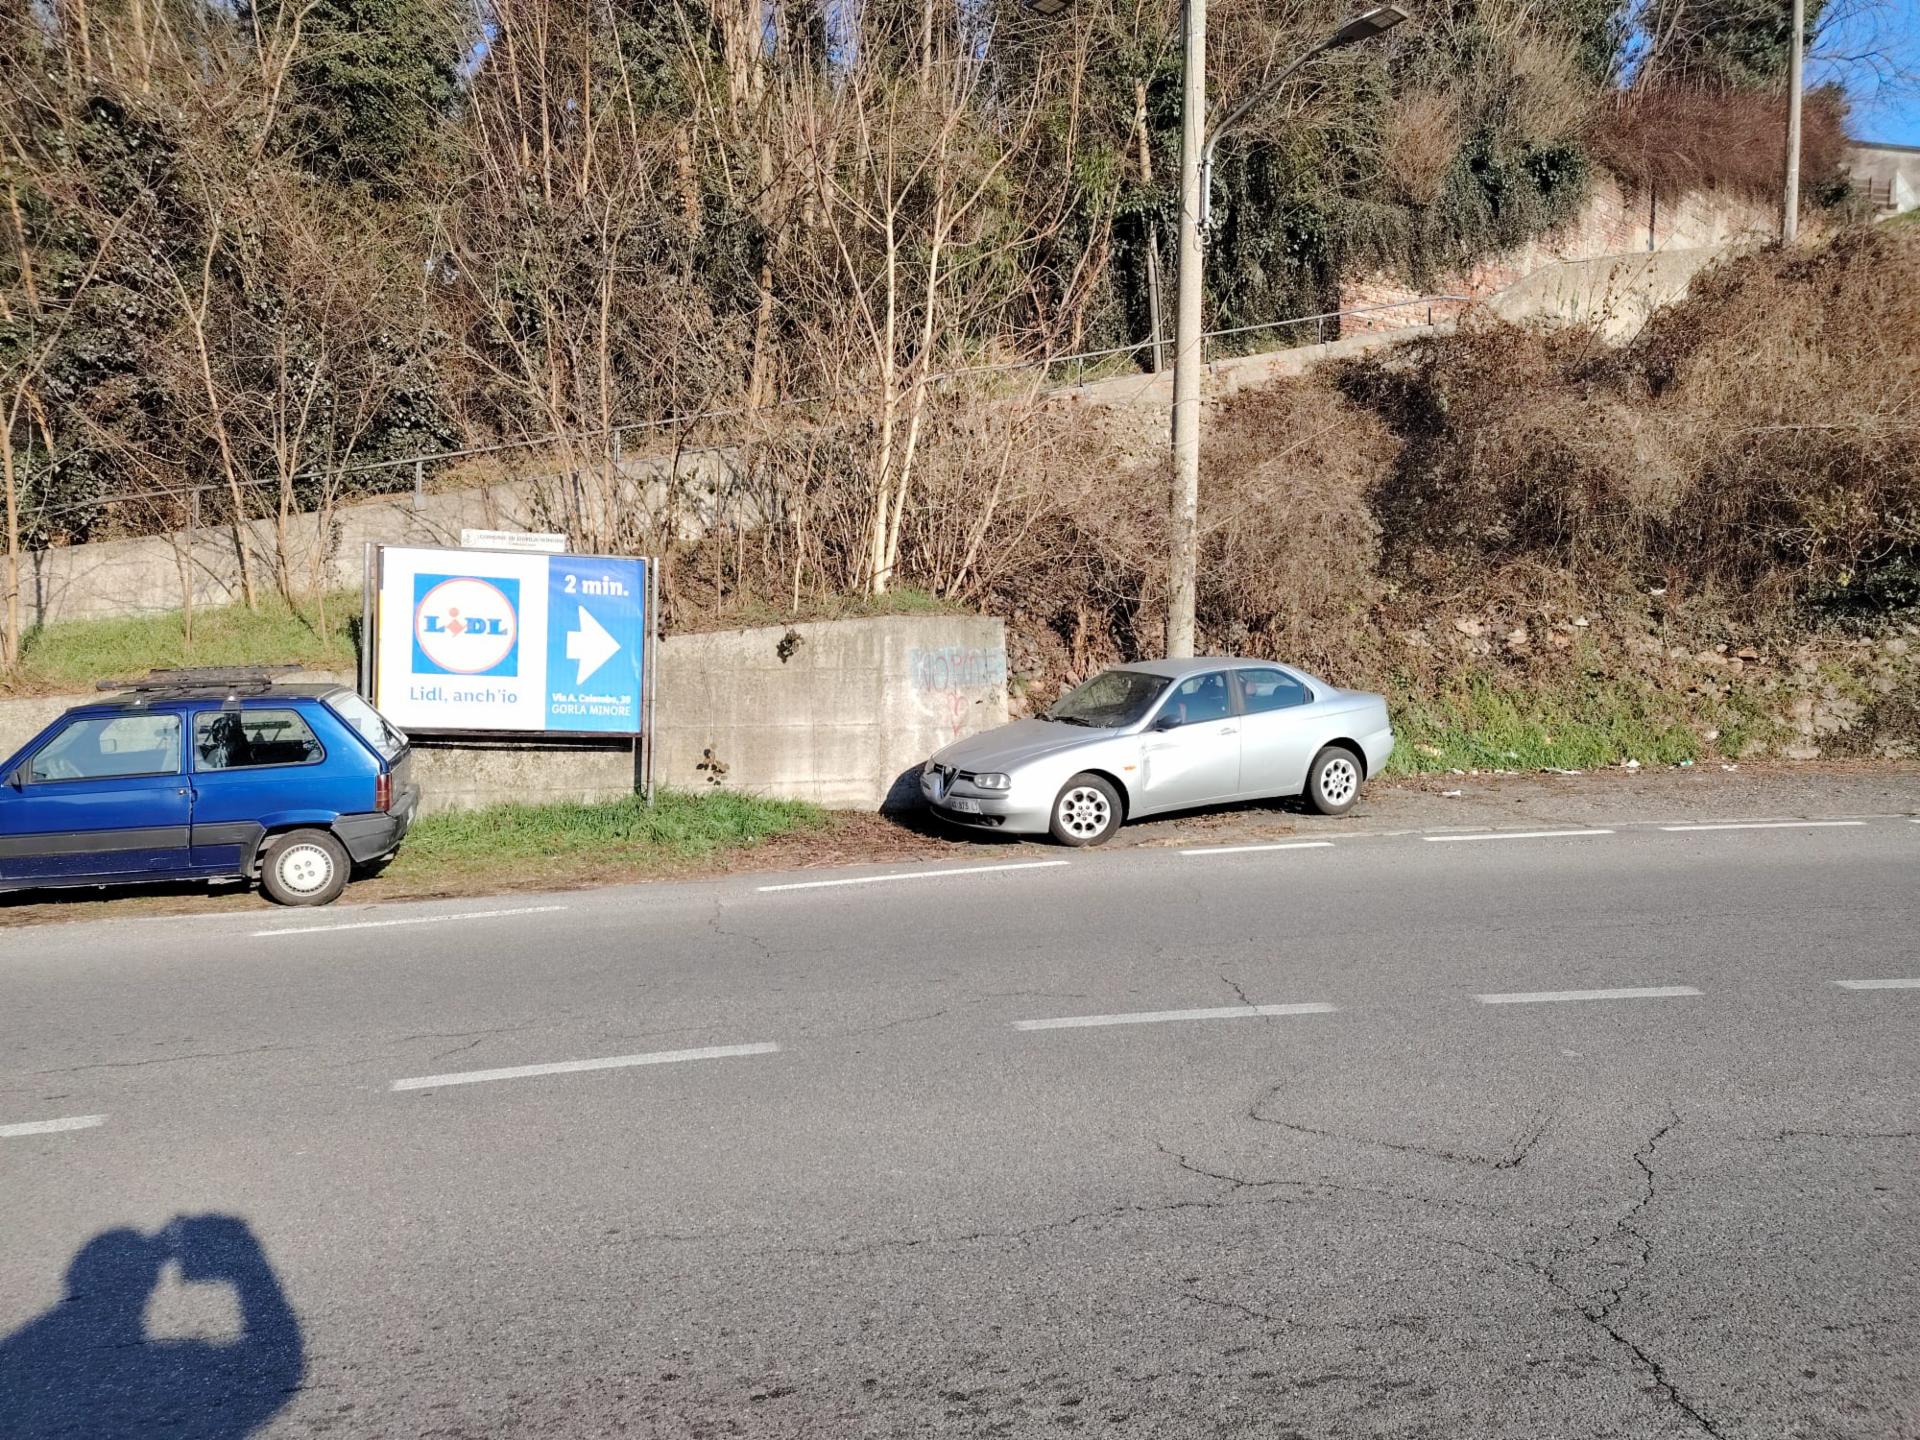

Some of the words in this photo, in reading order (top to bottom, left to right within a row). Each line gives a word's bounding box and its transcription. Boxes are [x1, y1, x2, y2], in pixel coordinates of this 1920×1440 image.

[564, 574, 577, 593] 2
[582, 575, 630, 597] min.
[409, 686, 448, 703] Lidl,
[453, 688, 518, 704] anch'io
[551, 692, 567, 702] Via
[551, 703, 587, 715] GORLA
[589, 704, 632, 717] MINORE
